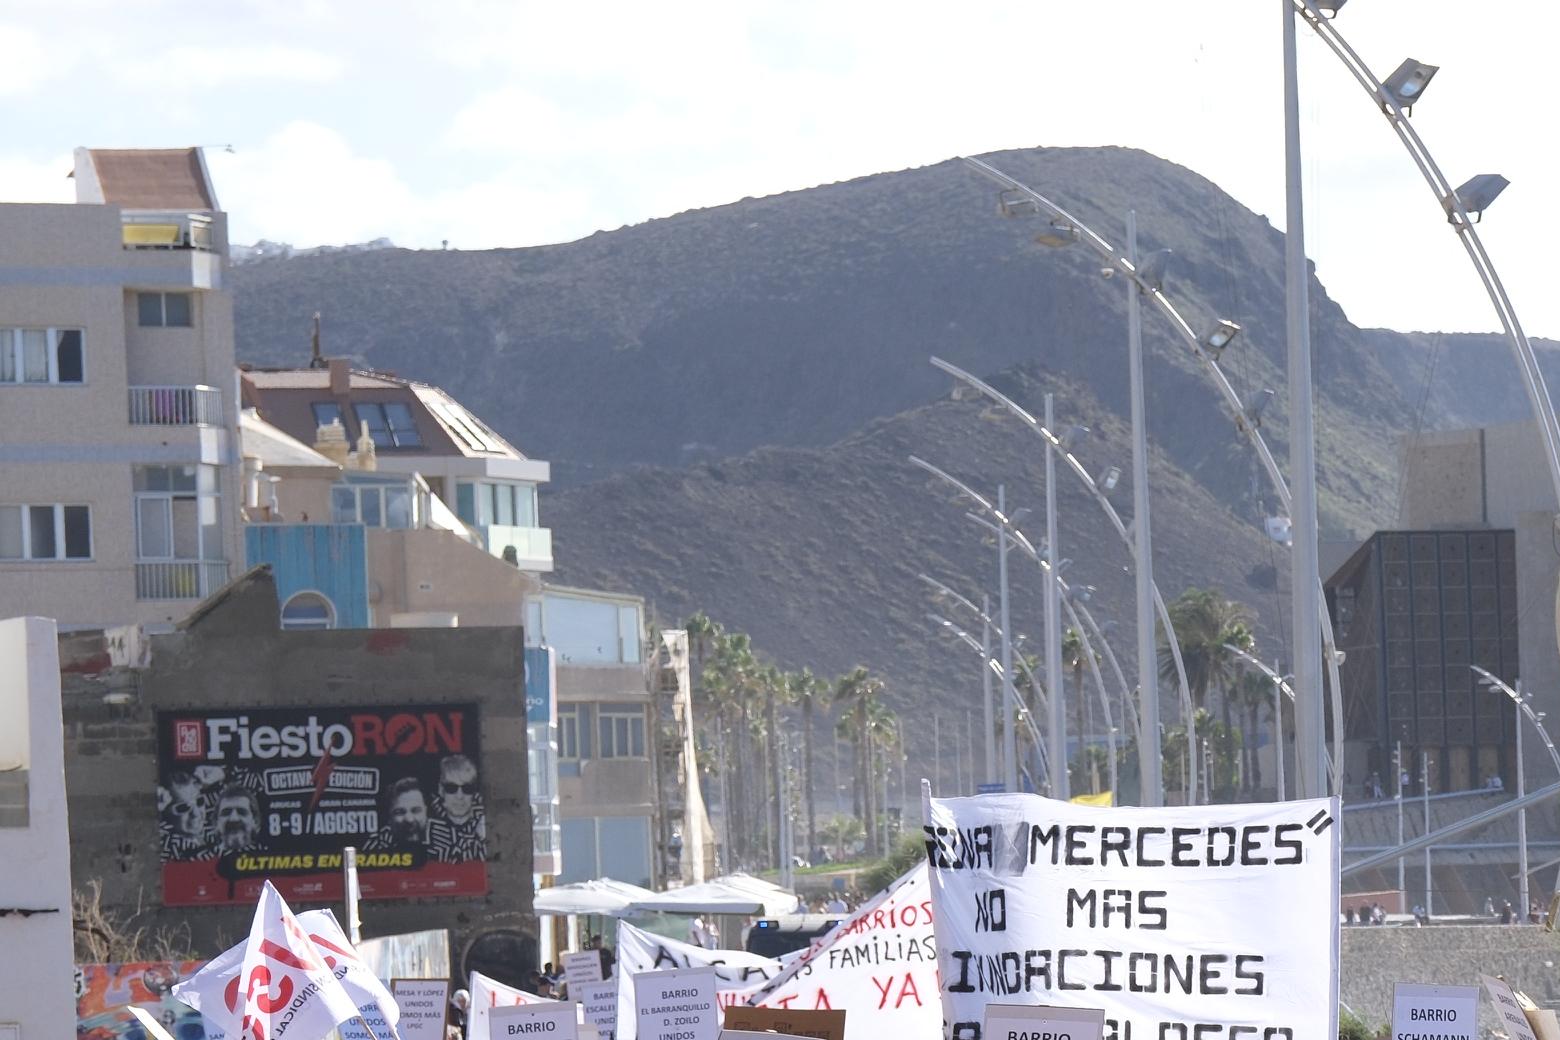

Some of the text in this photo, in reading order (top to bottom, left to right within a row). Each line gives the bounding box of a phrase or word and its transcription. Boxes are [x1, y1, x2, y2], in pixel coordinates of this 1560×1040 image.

[206, 711, 464, 760] FiestoRON
[328, 770, 373, 789] EDICIÓN
[313, 811, 378, 834] AGOSTO
[236, 853, 412, 870] ÚLTIMAS ENRADAS
[975, 887, 1168, 932] NO MAS
[829, 934, 936, 970] FAMILIAS
[661, 988, 698, 1000] BARRIO
[641, 1003, 710, 1016] EL BARRANQUILLO
[1411, 1008, 1457, 1022] BARRIO
[508, 1021, 556, 1035] BARRIO
[663, 1016, 700, 1027] D. ZOILO
